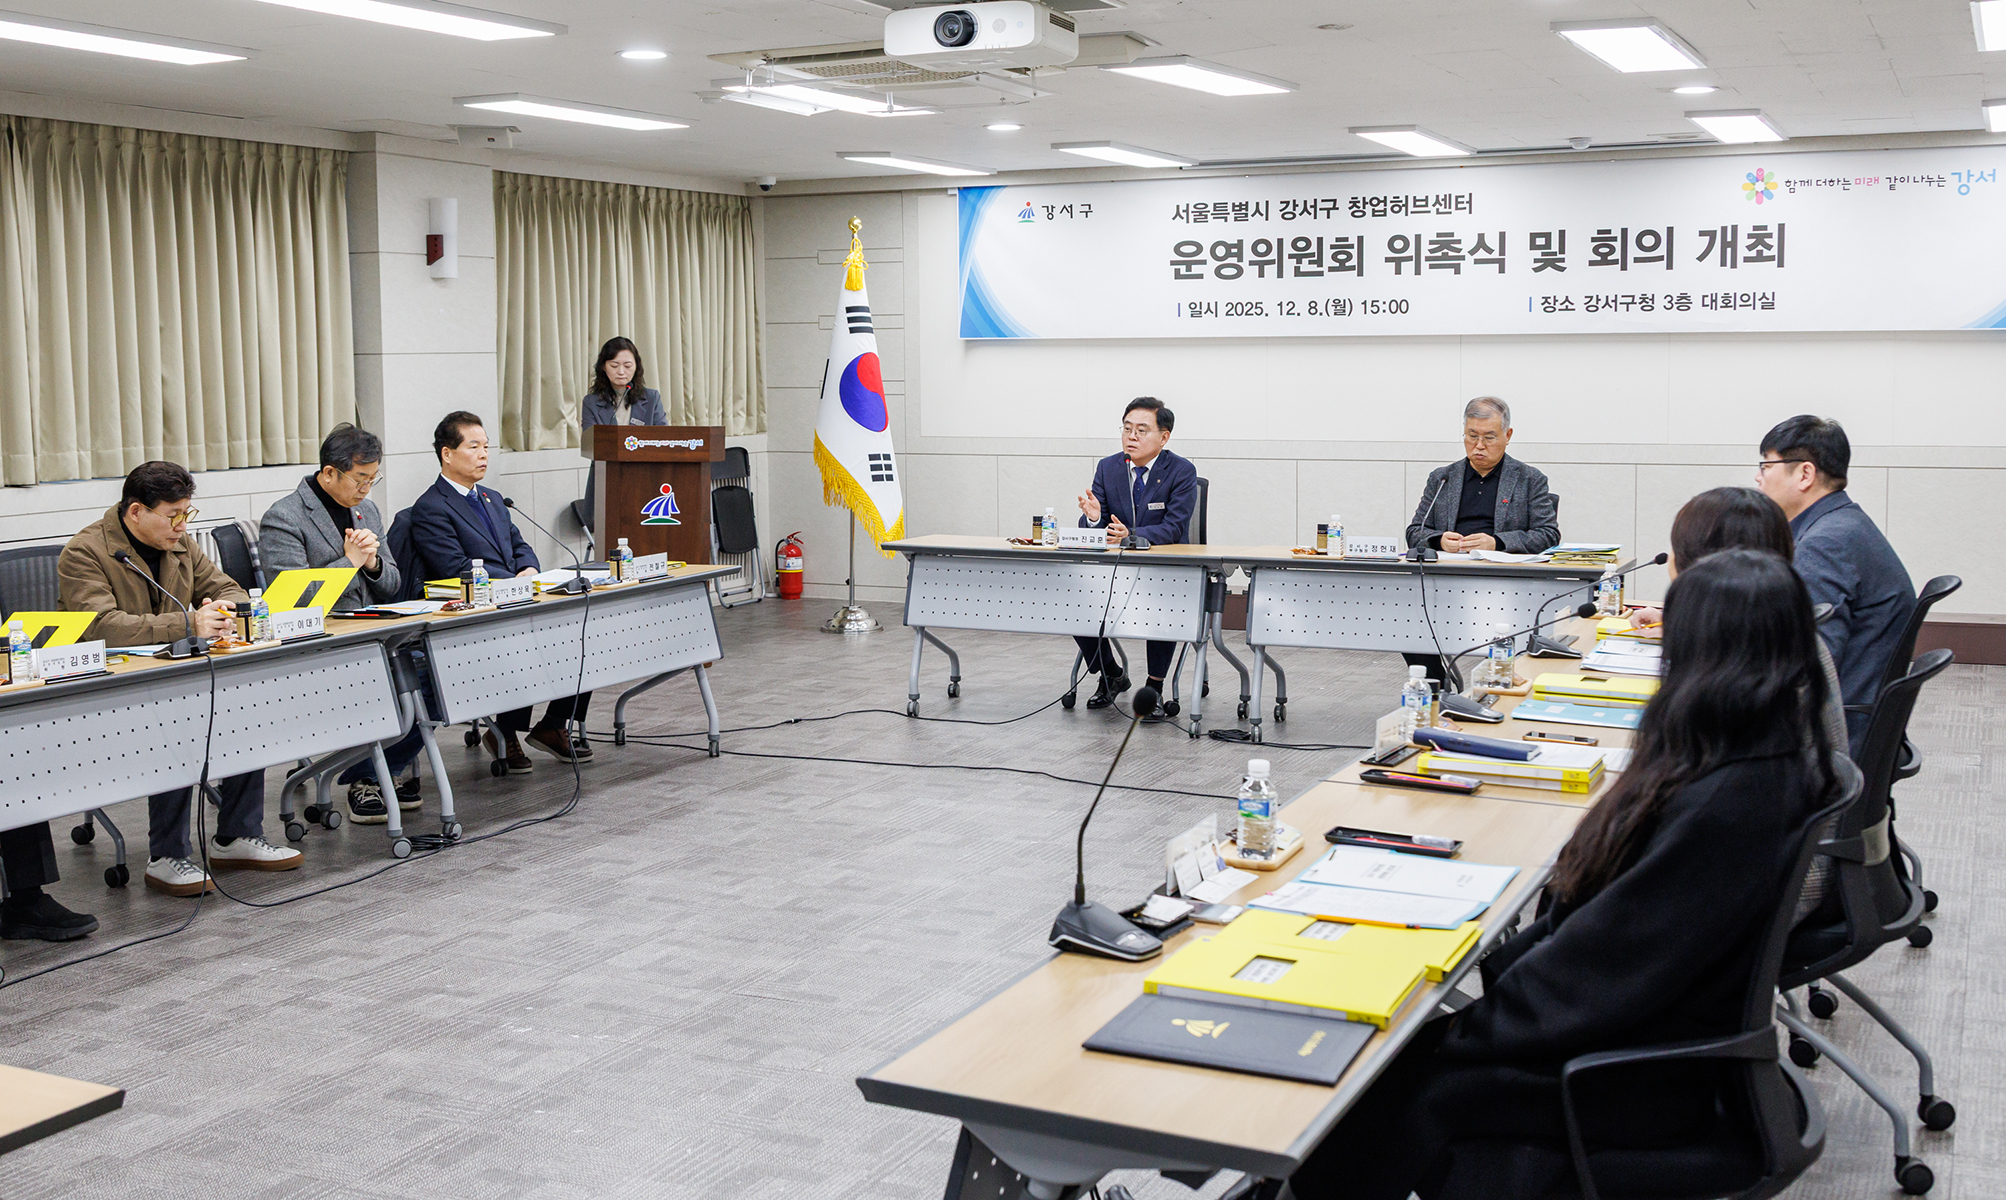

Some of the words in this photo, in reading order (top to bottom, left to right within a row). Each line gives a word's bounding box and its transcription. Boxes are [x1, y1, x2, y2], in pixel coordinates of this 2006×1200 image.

[1784, 178, 1813, 194] 함께
[1815, 177, 1852, 191] 더하는
[1854, 176, 1880, 187] 미래
[1885, 175, 1910, 191] 같이
[1912, 174, 1947, 188] 나누는
[1950, 168, 1996, 196] 강서
[1041, 203, 1094, 221] 강서구
[1171, 199, 1270, 224] 서울특별시
[1278, 197, 1340, 221] 강서구
[1347, 192, 1474, 219] 창업허브센터
[1169, 235, 1365, 281] 운영위원회
[1384, 231, 1507, 276] 위촉식
[1529, 229, 1568, 274] 및
[1588, 226, 1675, 272] 회의
[1695, 222, 1786, 270] 개최
[1188, 300, 1219, 318] 일시
[1225, 301, 1269, 318] 2025.
[1276, 300, 1301, 317] 12.
[1307, 297, 1354, 318] 8.(월)
[1360, 298, 1410, 315] 15:00
[1540, 294, 1576, 314] 장소
[1583, 293, 1655, 313] 강서구청
[1662, 292, 1693, 312] 3층
[1701, 291, 1776, 311] 대회의실
[70, 652, 100, 667] 김영범
